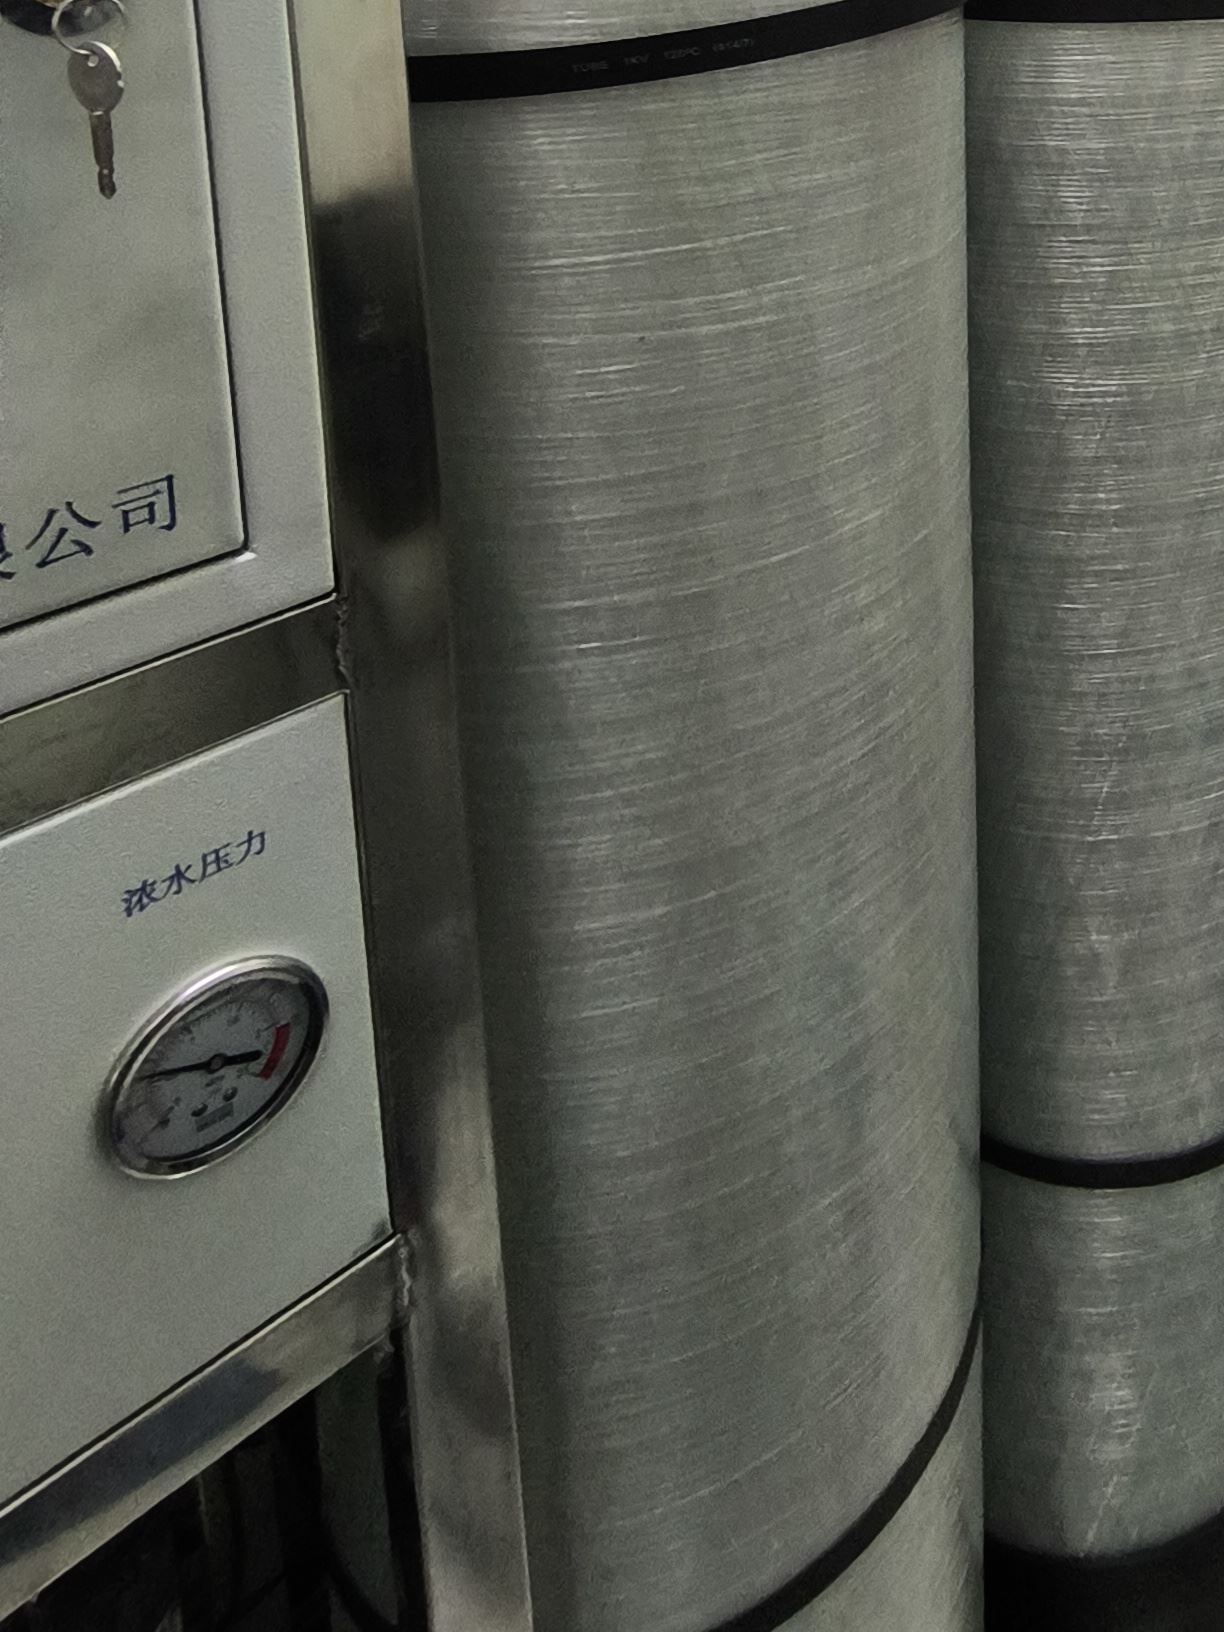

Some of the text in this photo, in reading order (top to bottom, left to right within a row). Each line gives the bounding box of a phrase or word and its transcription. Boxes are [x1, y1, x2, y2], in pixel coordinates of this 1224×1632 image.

[0, 473, 177, 580] 公司
[121, 830, 266, 917] 浓水压力
